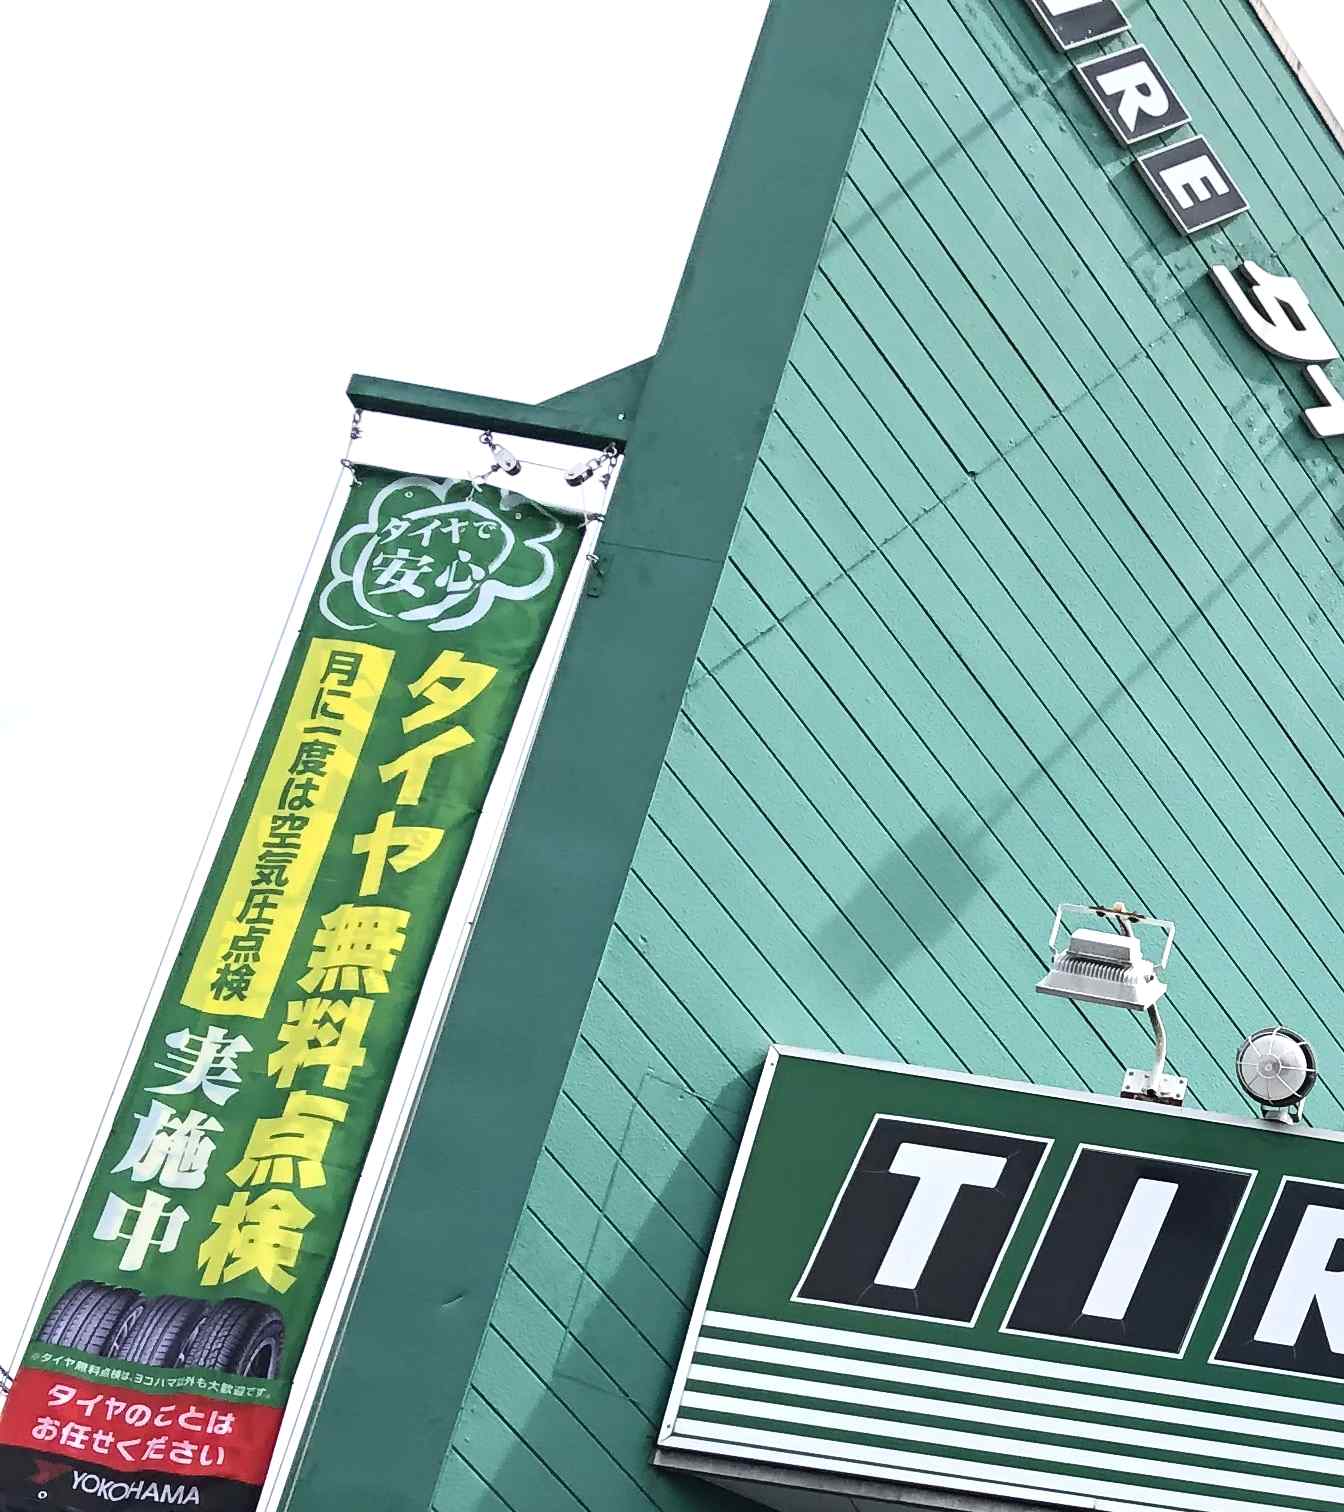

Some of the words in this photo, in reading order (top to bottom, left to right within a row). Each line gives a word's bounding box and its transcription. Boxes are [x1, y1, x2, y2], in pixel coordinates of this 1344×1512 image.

[378, 515, 498, 547] タイヤで
[371, 548, 488, 600] 安心
[209, 651, 363, 1002] 月に一度は空気圧点検
[198, 649, 498, 1294] タイヤ無料点検
[92, 1025, 254, 1273] 実施中
[47, 1383, 236, 1436] タイヤのことは
[31, 1416, 225, 1467] お任せください
[71, 1470, 201, 1505] YOKOHAMA
